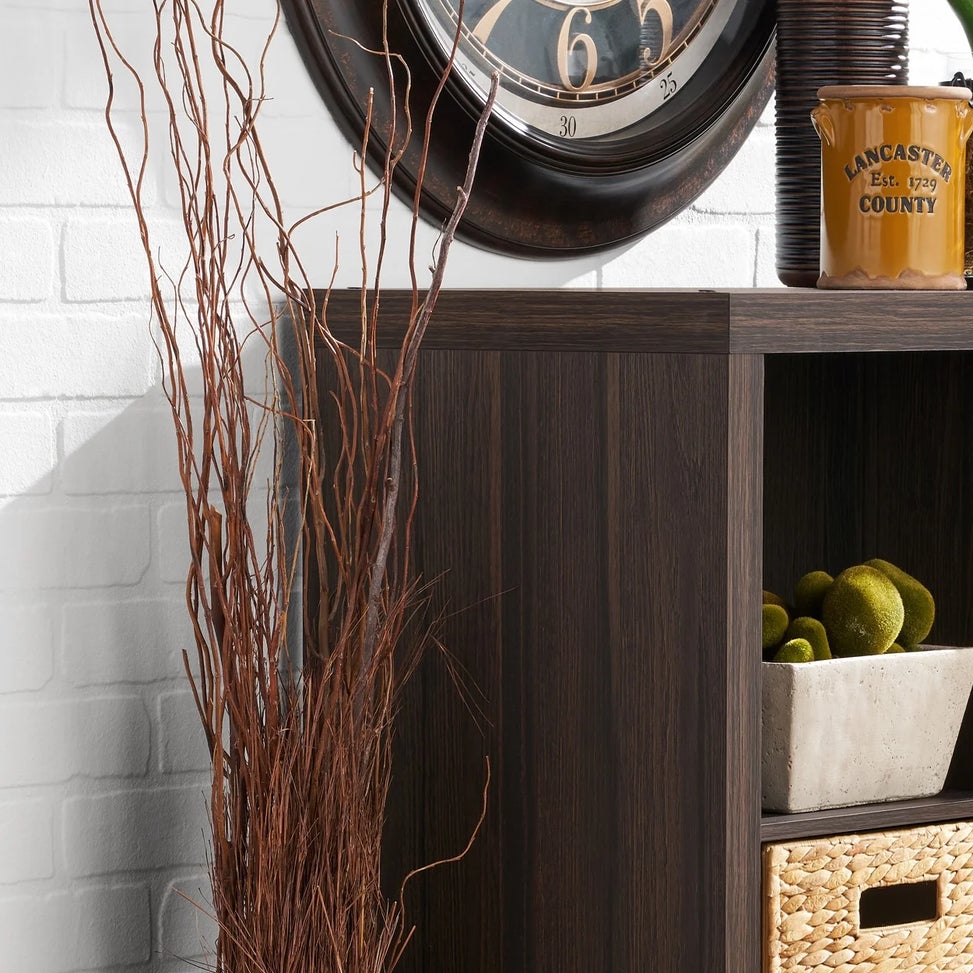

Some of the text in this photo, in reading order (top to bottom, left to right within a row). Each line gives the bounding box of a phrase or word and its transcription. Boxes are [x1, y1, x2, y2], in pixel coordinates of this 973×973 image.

[636, 0, 674, 66] 5
[557, 7, 598, 91] 6
[660, 71, 678, 100] 25
[559, 115, 577, 137] 30
[844, 143, 953, 182] LANCASTER
[870, 171, 938, 192] Est. 1729
[859, 195, 937, 213] COUNTY
